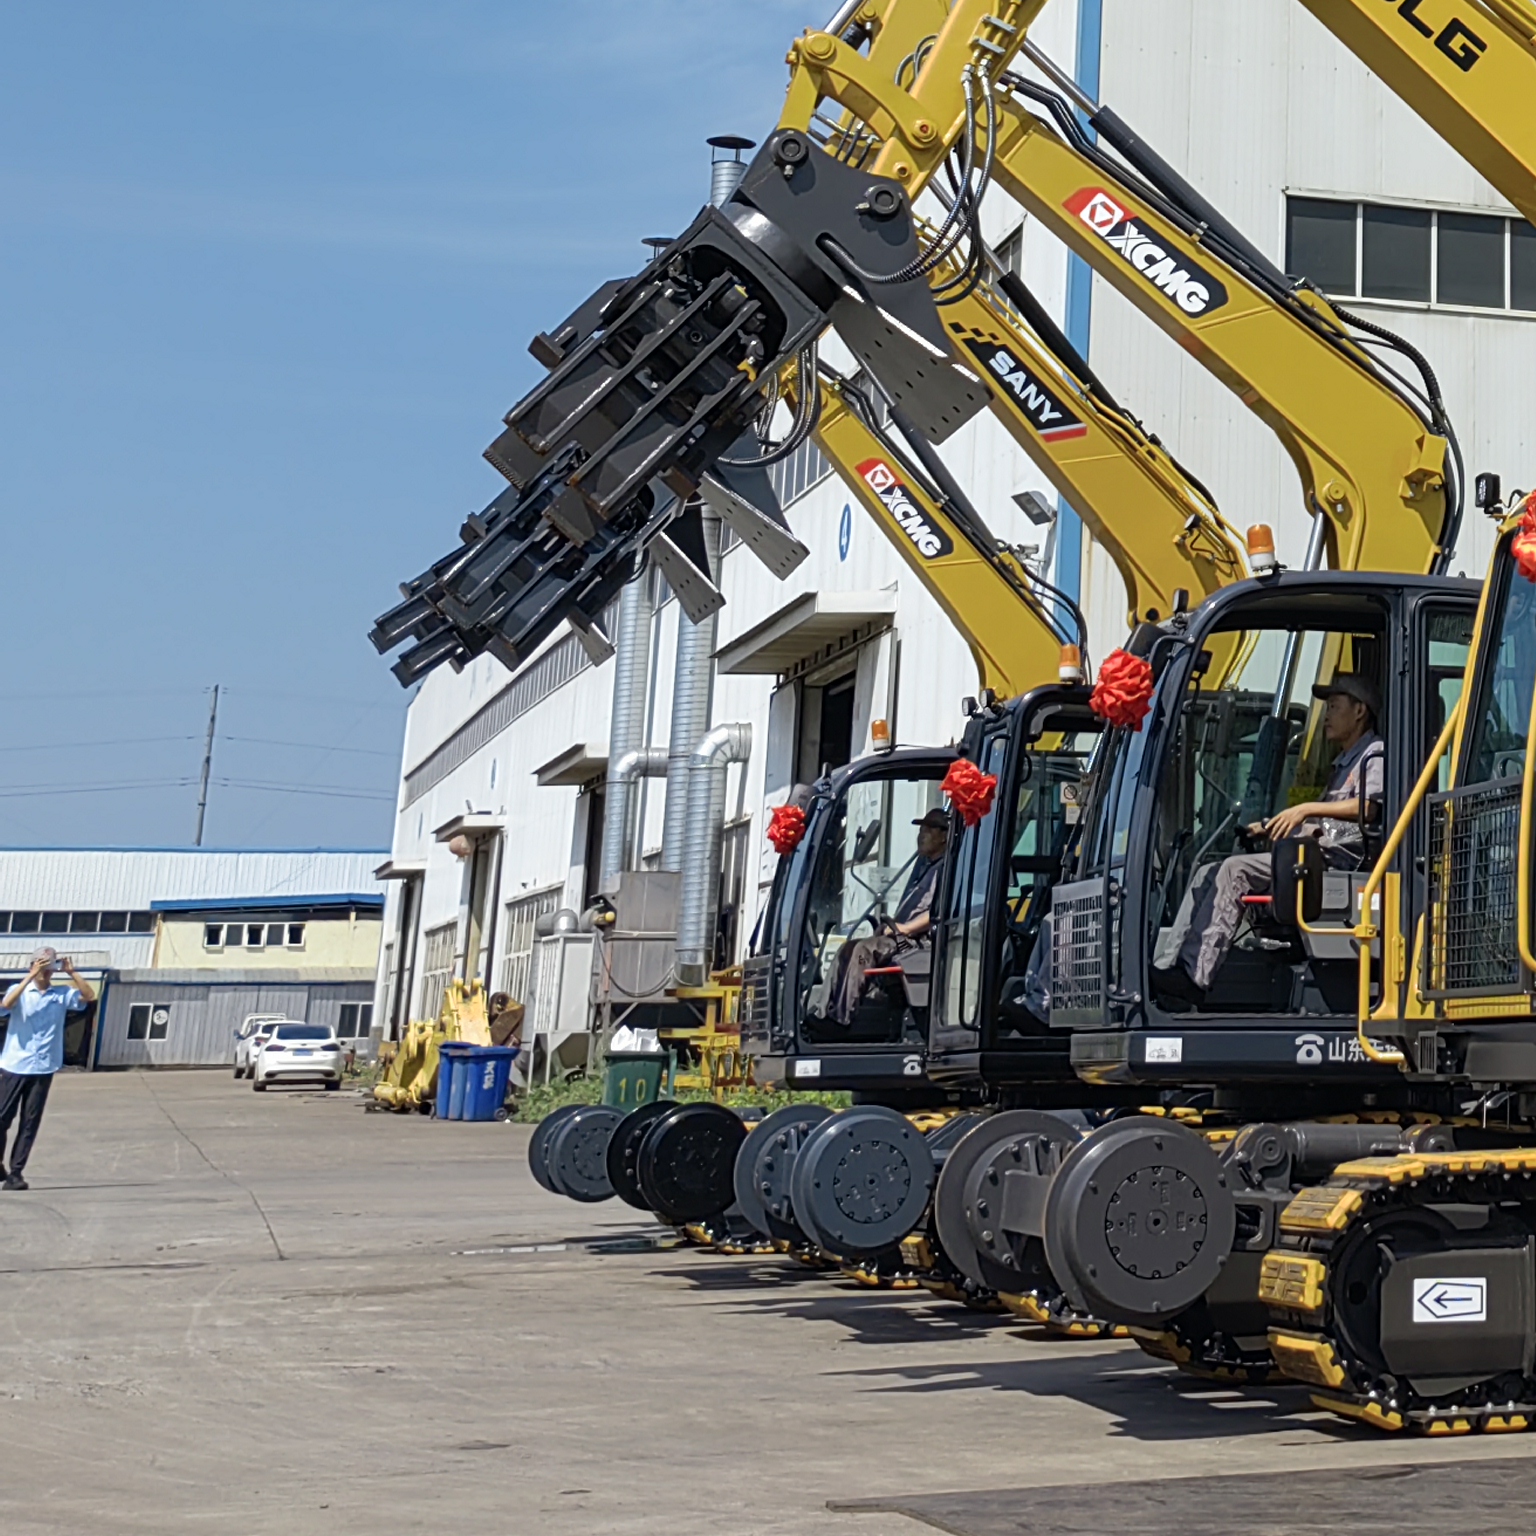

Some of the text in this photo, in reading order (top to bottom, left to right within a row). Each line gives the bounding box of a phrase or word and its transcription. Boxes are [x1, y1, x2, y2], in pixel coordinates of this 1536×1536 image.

[1104, 220, 1210, 313] XCMG
[988, 350, 1063, 423] SANY
[879, 485, 942, 556] XCMG
[619, 1077, 646, 1102] 10
